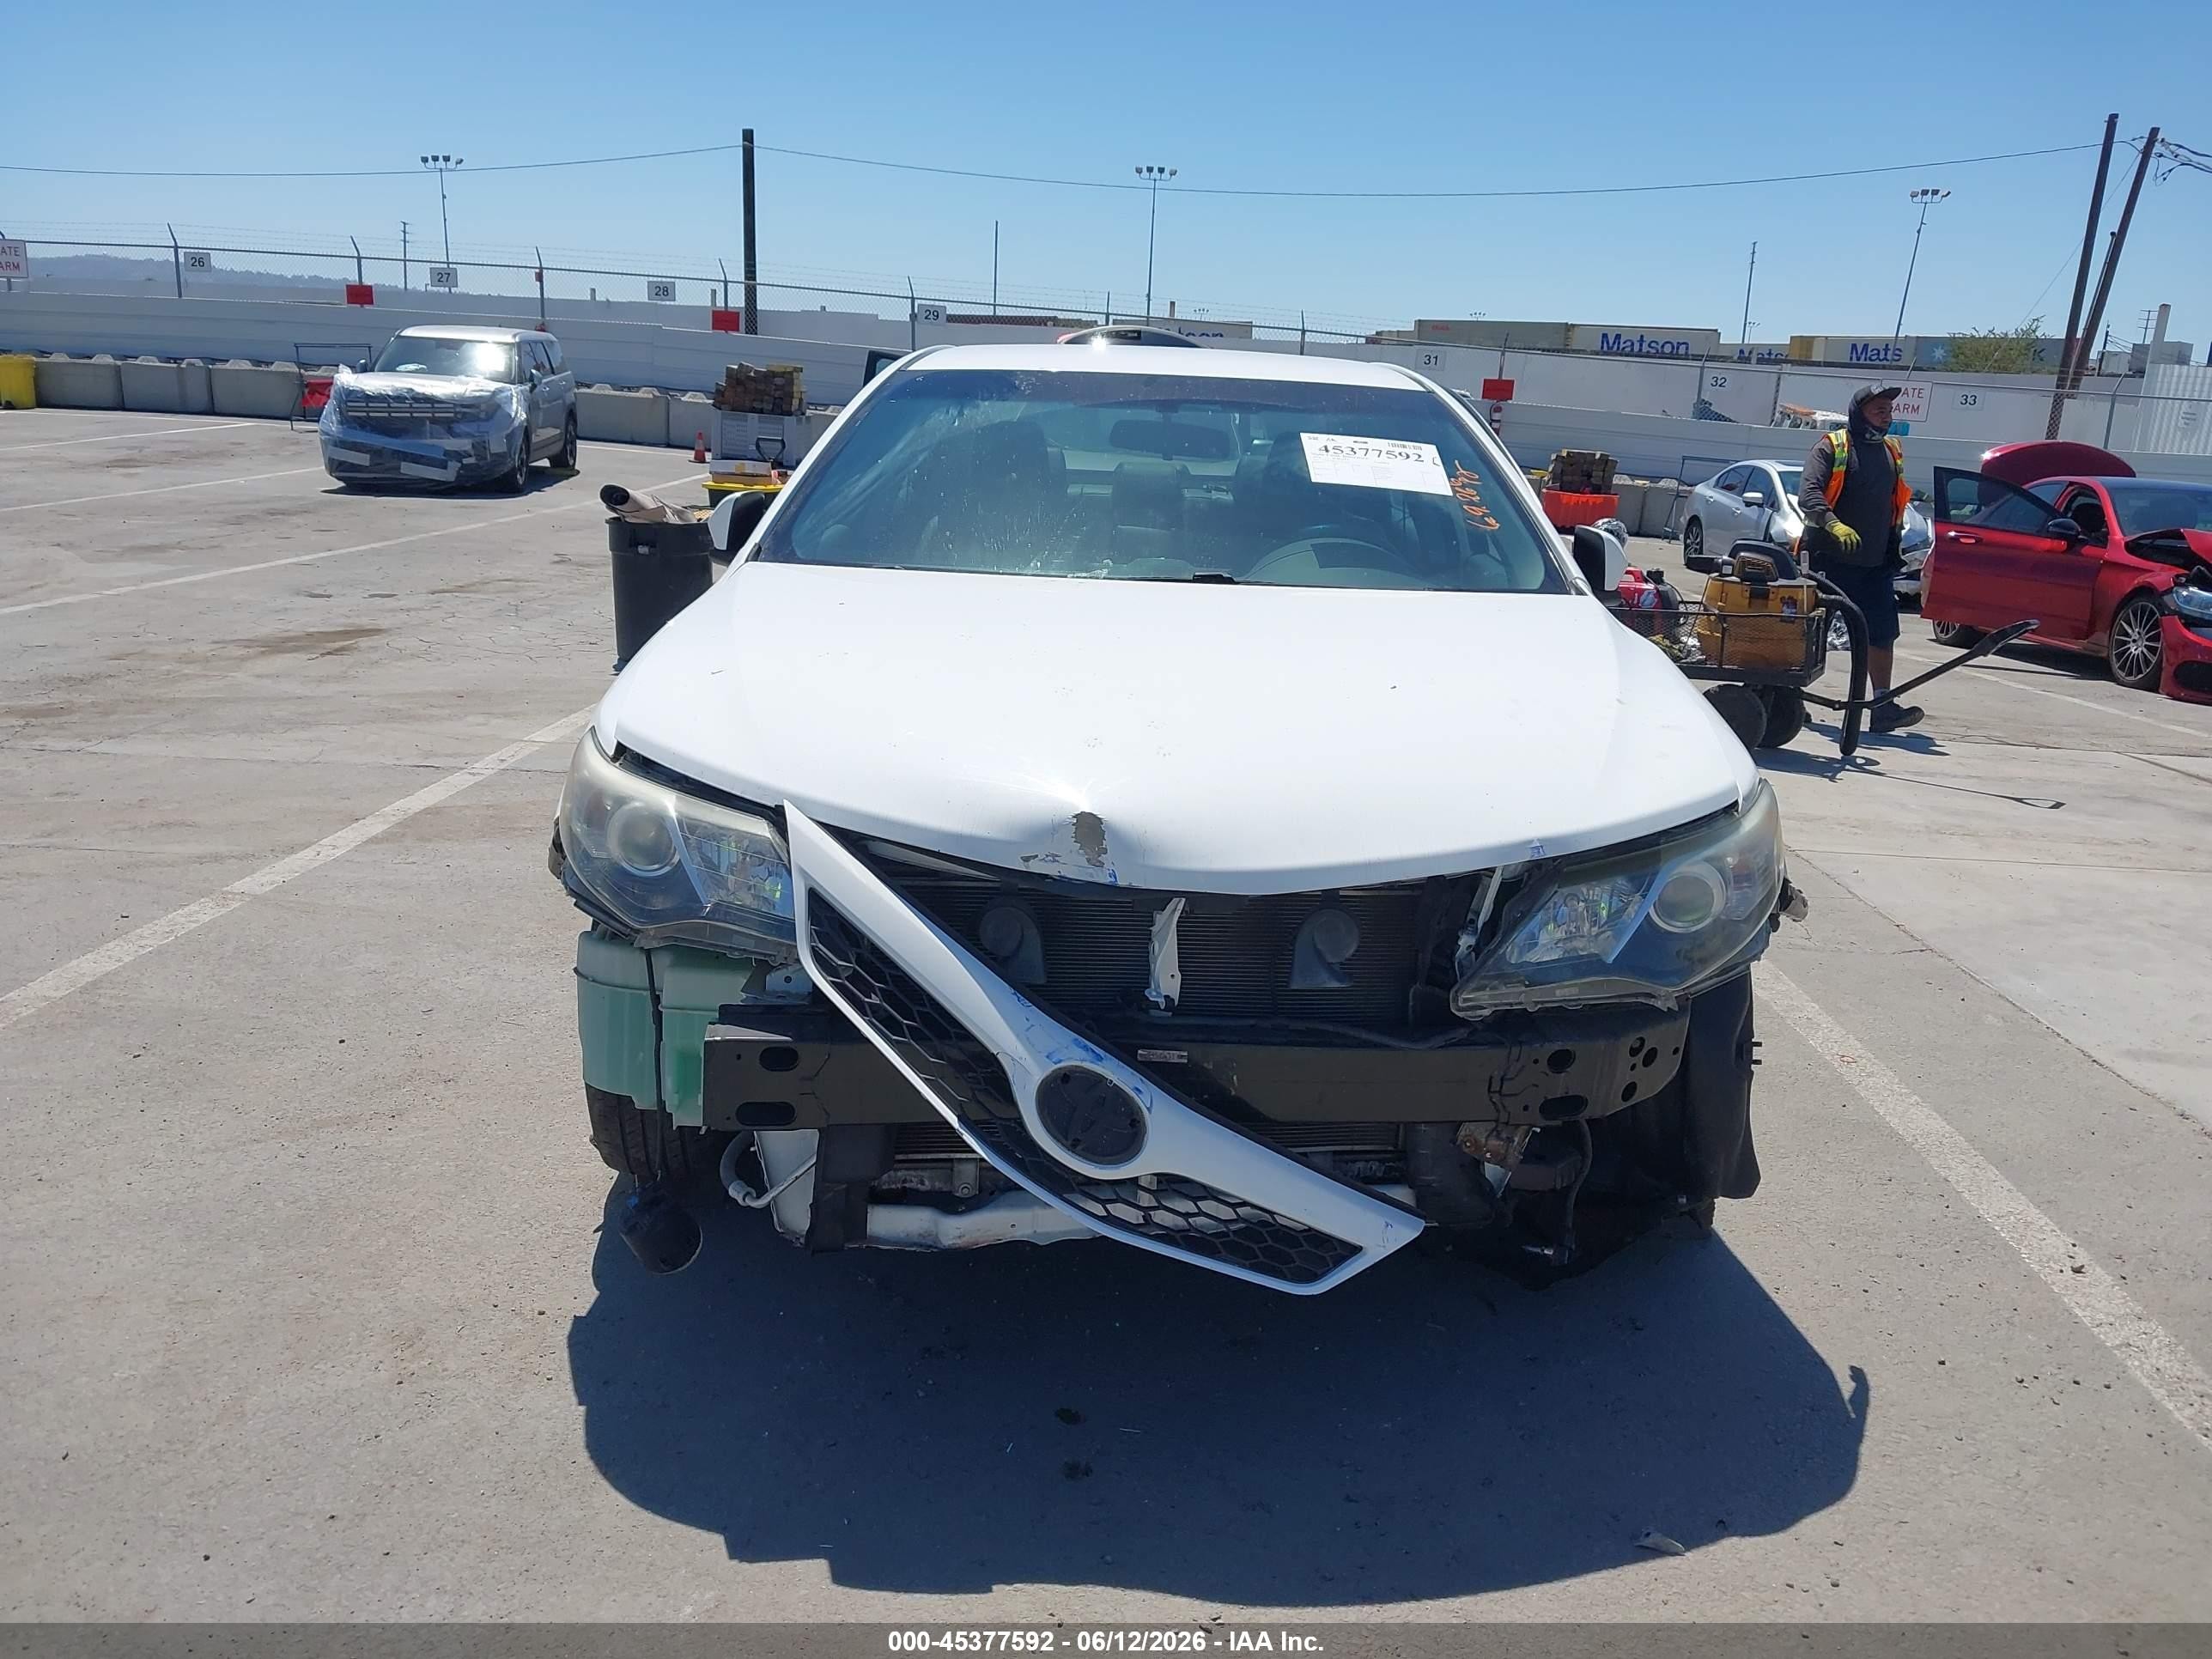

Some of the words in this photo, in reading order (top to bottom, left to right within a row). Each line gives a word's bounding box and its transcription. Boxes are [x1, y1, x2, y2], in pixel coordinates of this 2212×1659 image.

[190, 256, 206, 269] 26
[436, 271, 452, 283] 27
[653, 285, 670, 297] 28
[923, 308, 940, 321] 29
[1600, 332, 1690, 356] Matson
[1423, 353, 1439, 367] 31
[1710, 375, 1727, 388] 32
[1959, 393, 1978, 406] 33
[1319, 444, 1425, 464] 45377592
